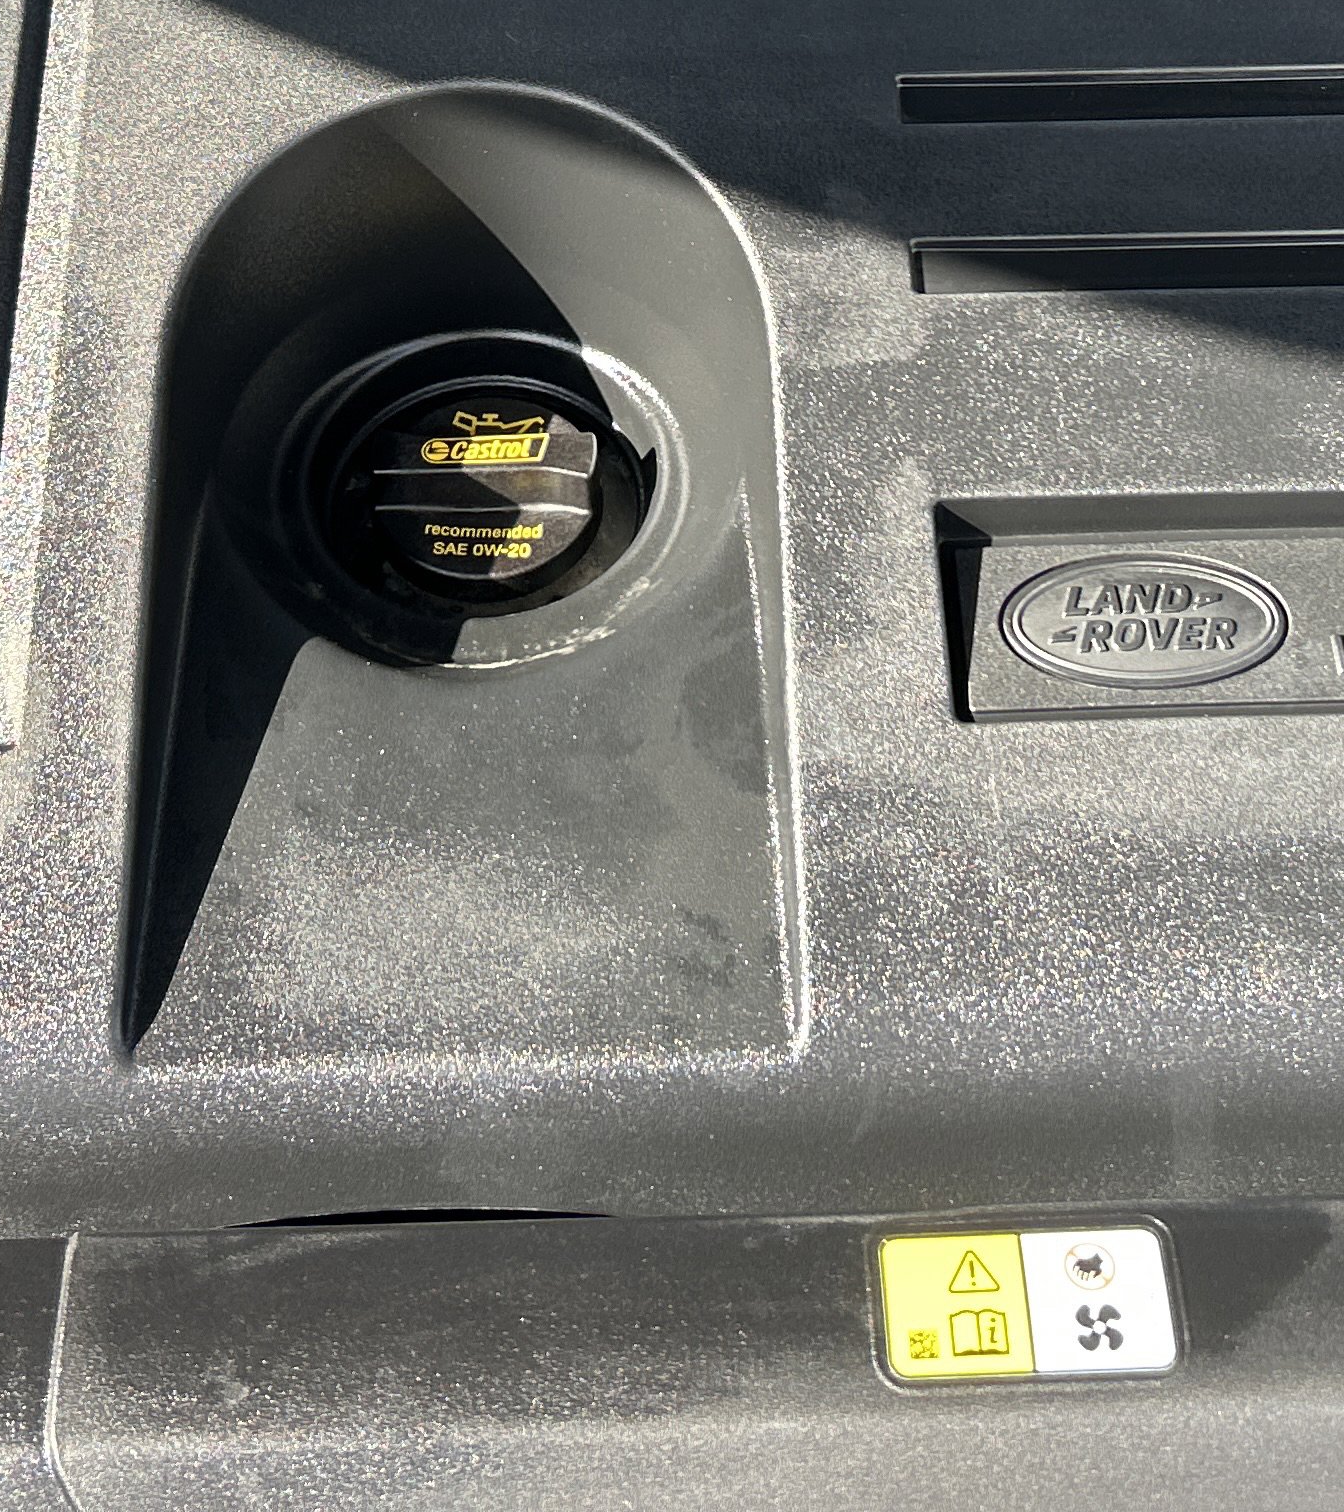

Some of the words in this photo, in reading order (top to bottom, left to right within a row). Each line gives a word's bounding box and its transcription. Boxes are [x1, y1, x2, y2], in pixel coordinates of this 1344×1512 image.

[450, 438, 532, 460] Castrol
[424, 522, 544, 539] recommended
[433, 541, 469, 556] SAE
[472, 542, 532, 558] 0W-20
[1062, 584, 1193, 617] LAND
[1077, 617, 1239, 654] ROVER
